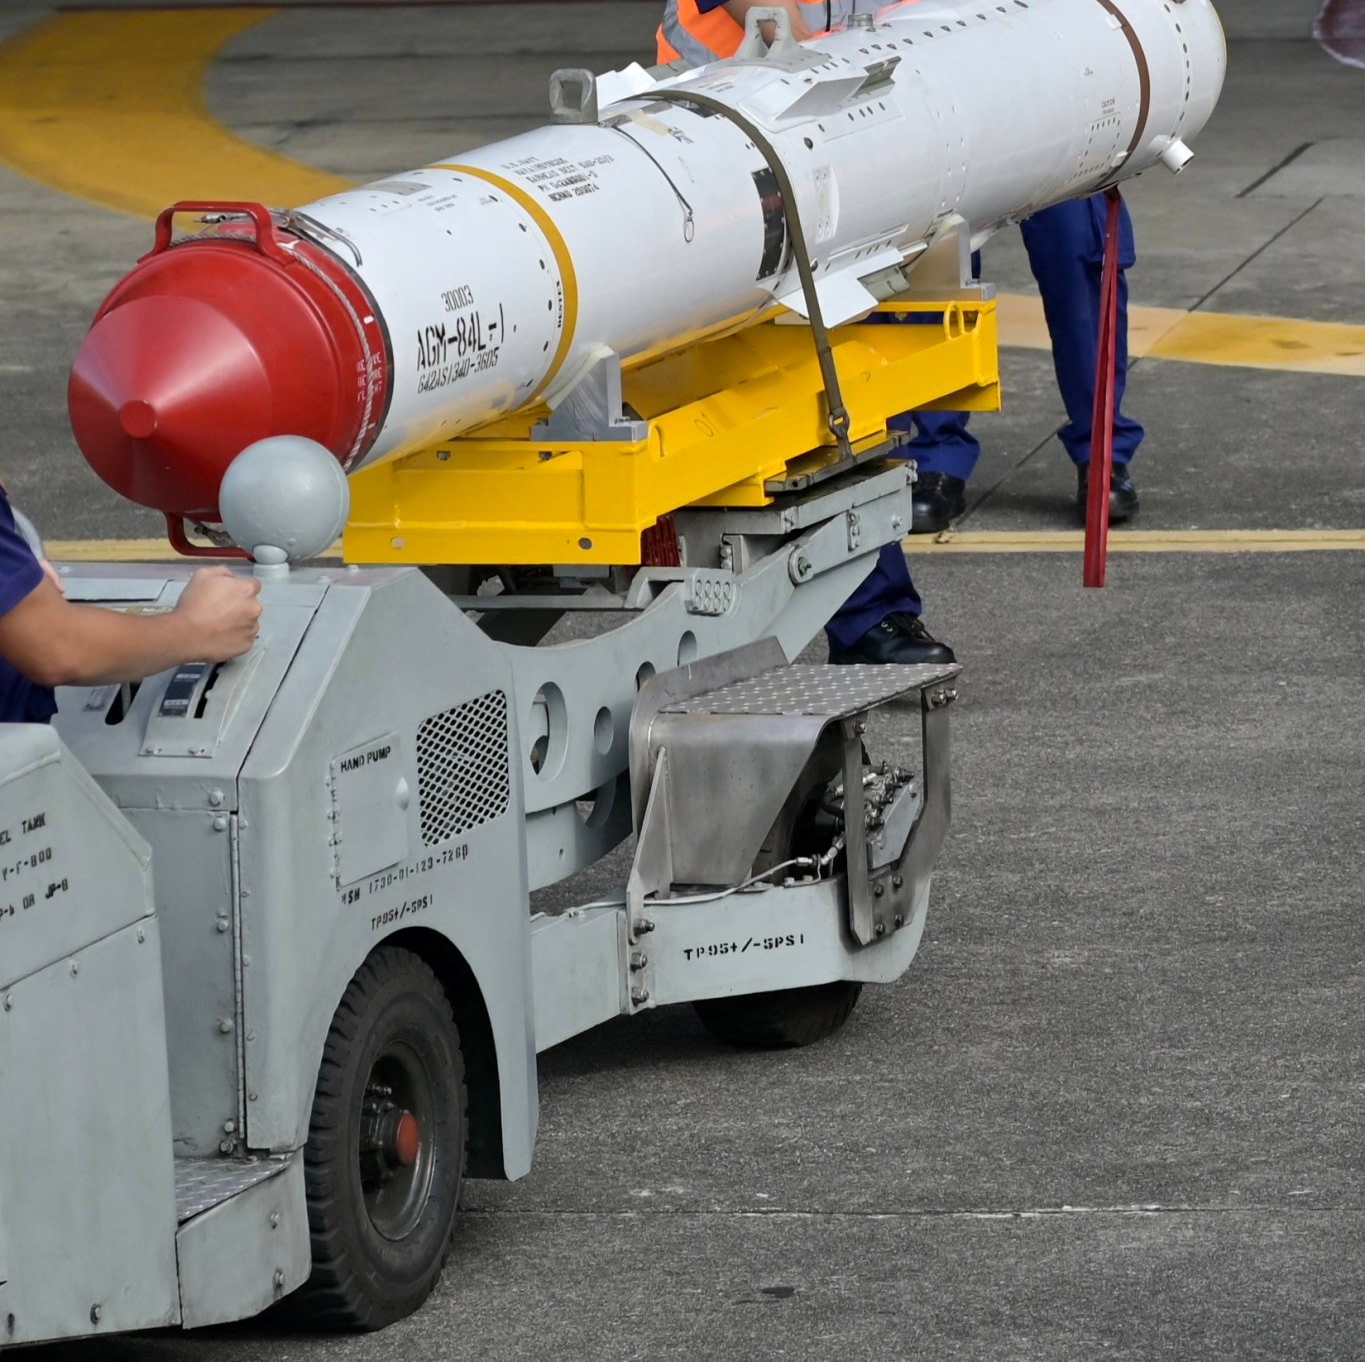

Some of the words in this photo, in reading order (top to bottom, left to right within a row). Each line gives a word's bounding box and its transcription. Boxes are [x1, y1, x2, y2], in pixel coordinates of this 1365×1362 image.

[441, 285, 475, 313] 30003
[340, 755, 365, 773] HAND
[366, 745, 391, 765] PUMP
[22, 812, 46, 834] TANK
